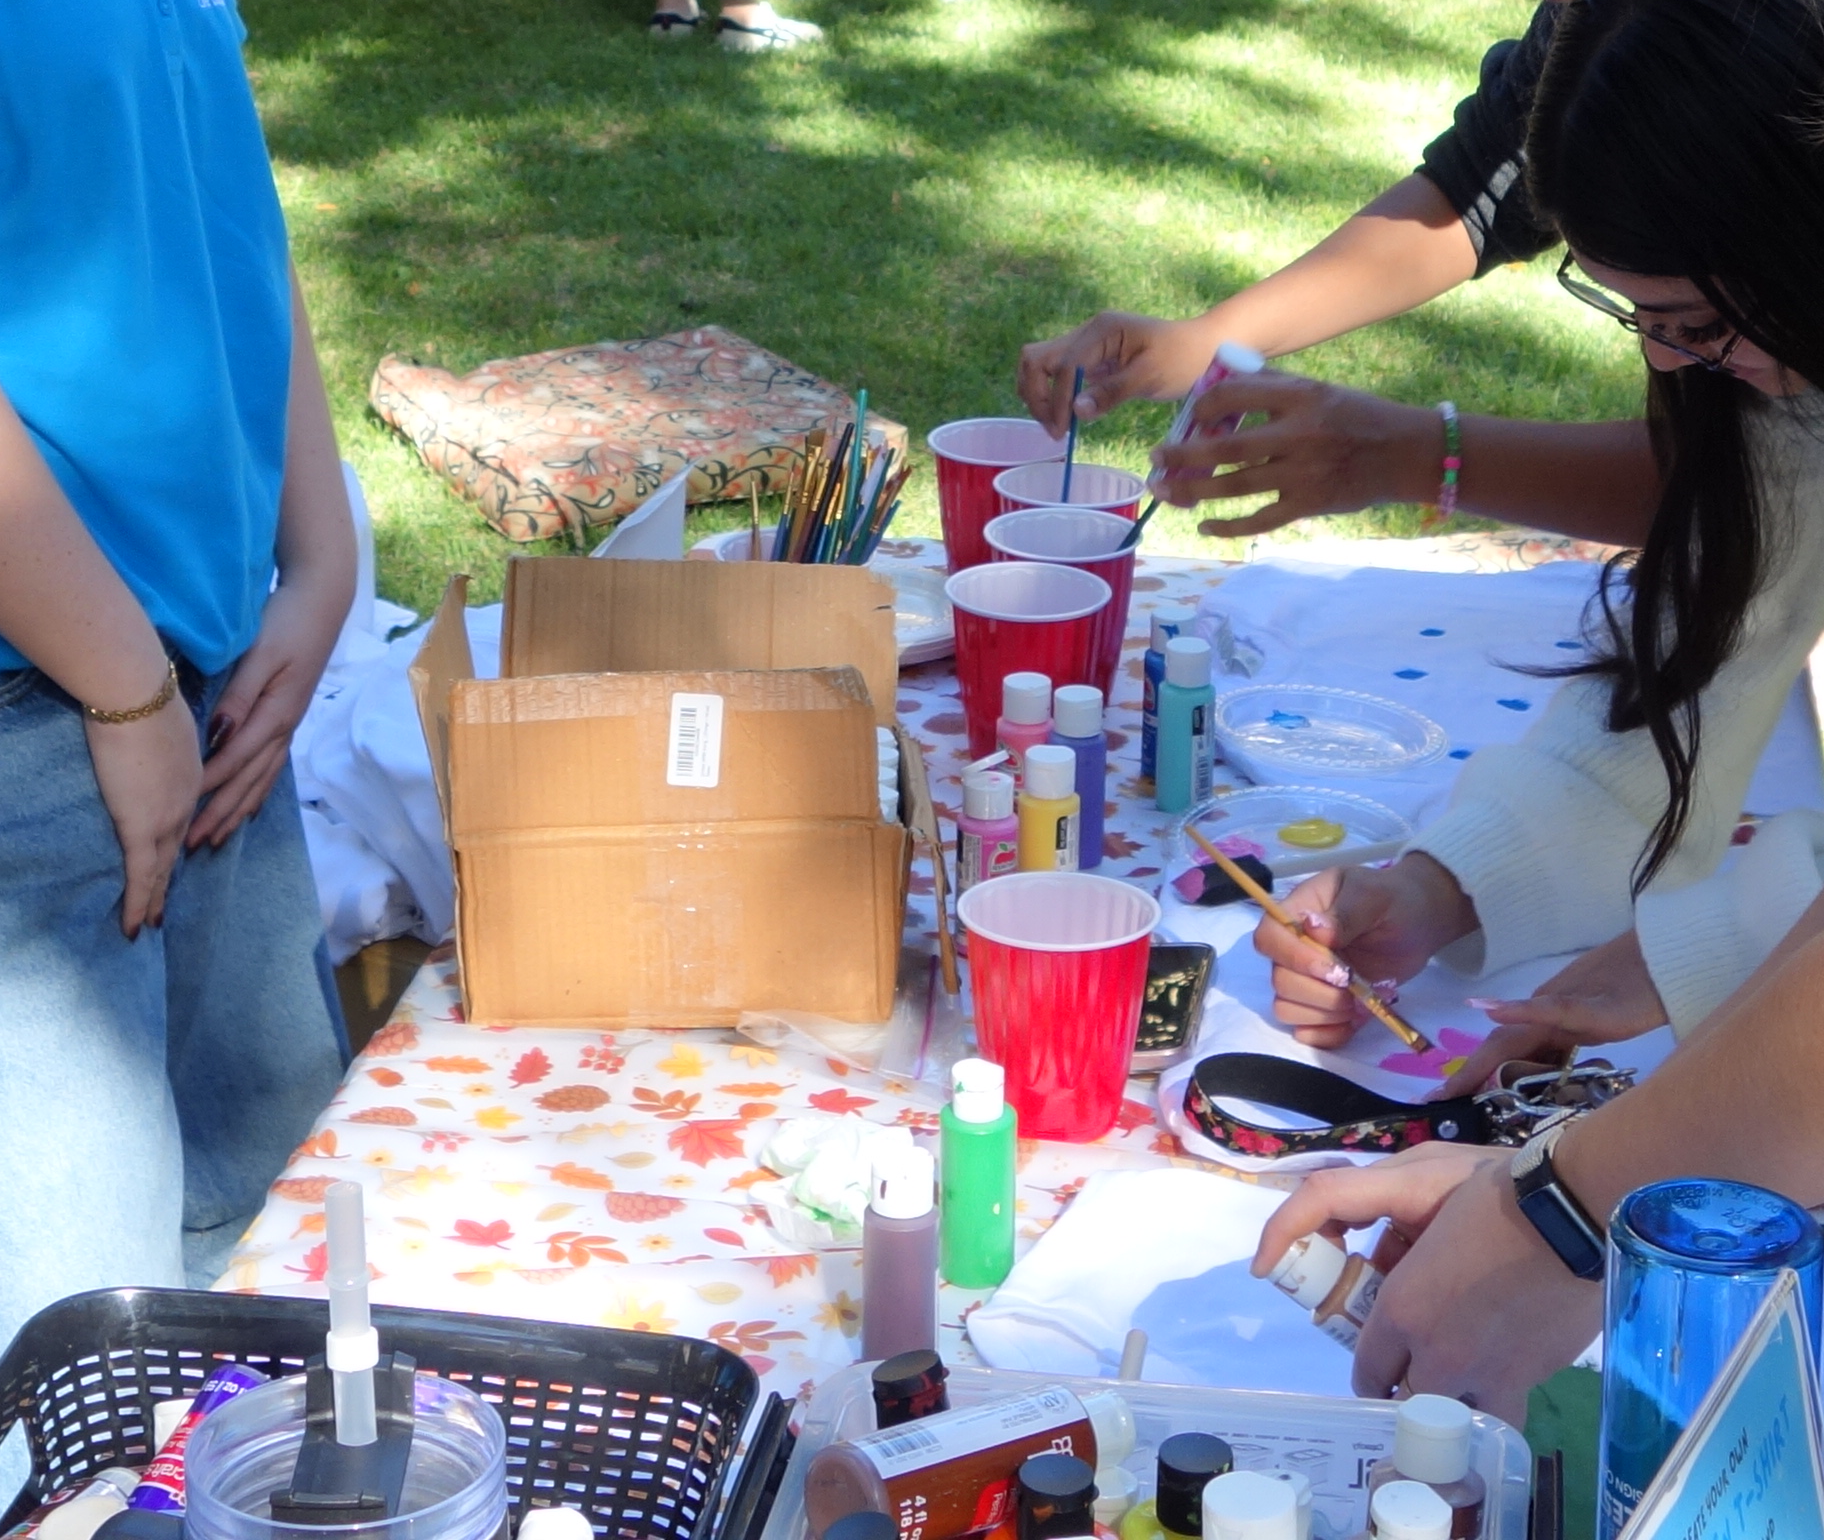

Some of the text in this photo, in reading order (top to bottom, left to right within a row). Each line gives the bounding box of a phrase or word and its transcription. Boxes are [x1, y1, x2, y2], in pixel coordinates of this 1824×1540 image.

[1706, 1474, 1730, 1517] YOUR
[1728, 1427, 1750, 1473] OWN
[1733, 1394, 1791, 1532] T-SHIRT
[899, 1499, 913, 1528] 118
[914, 1495, 927, 1508] 4
